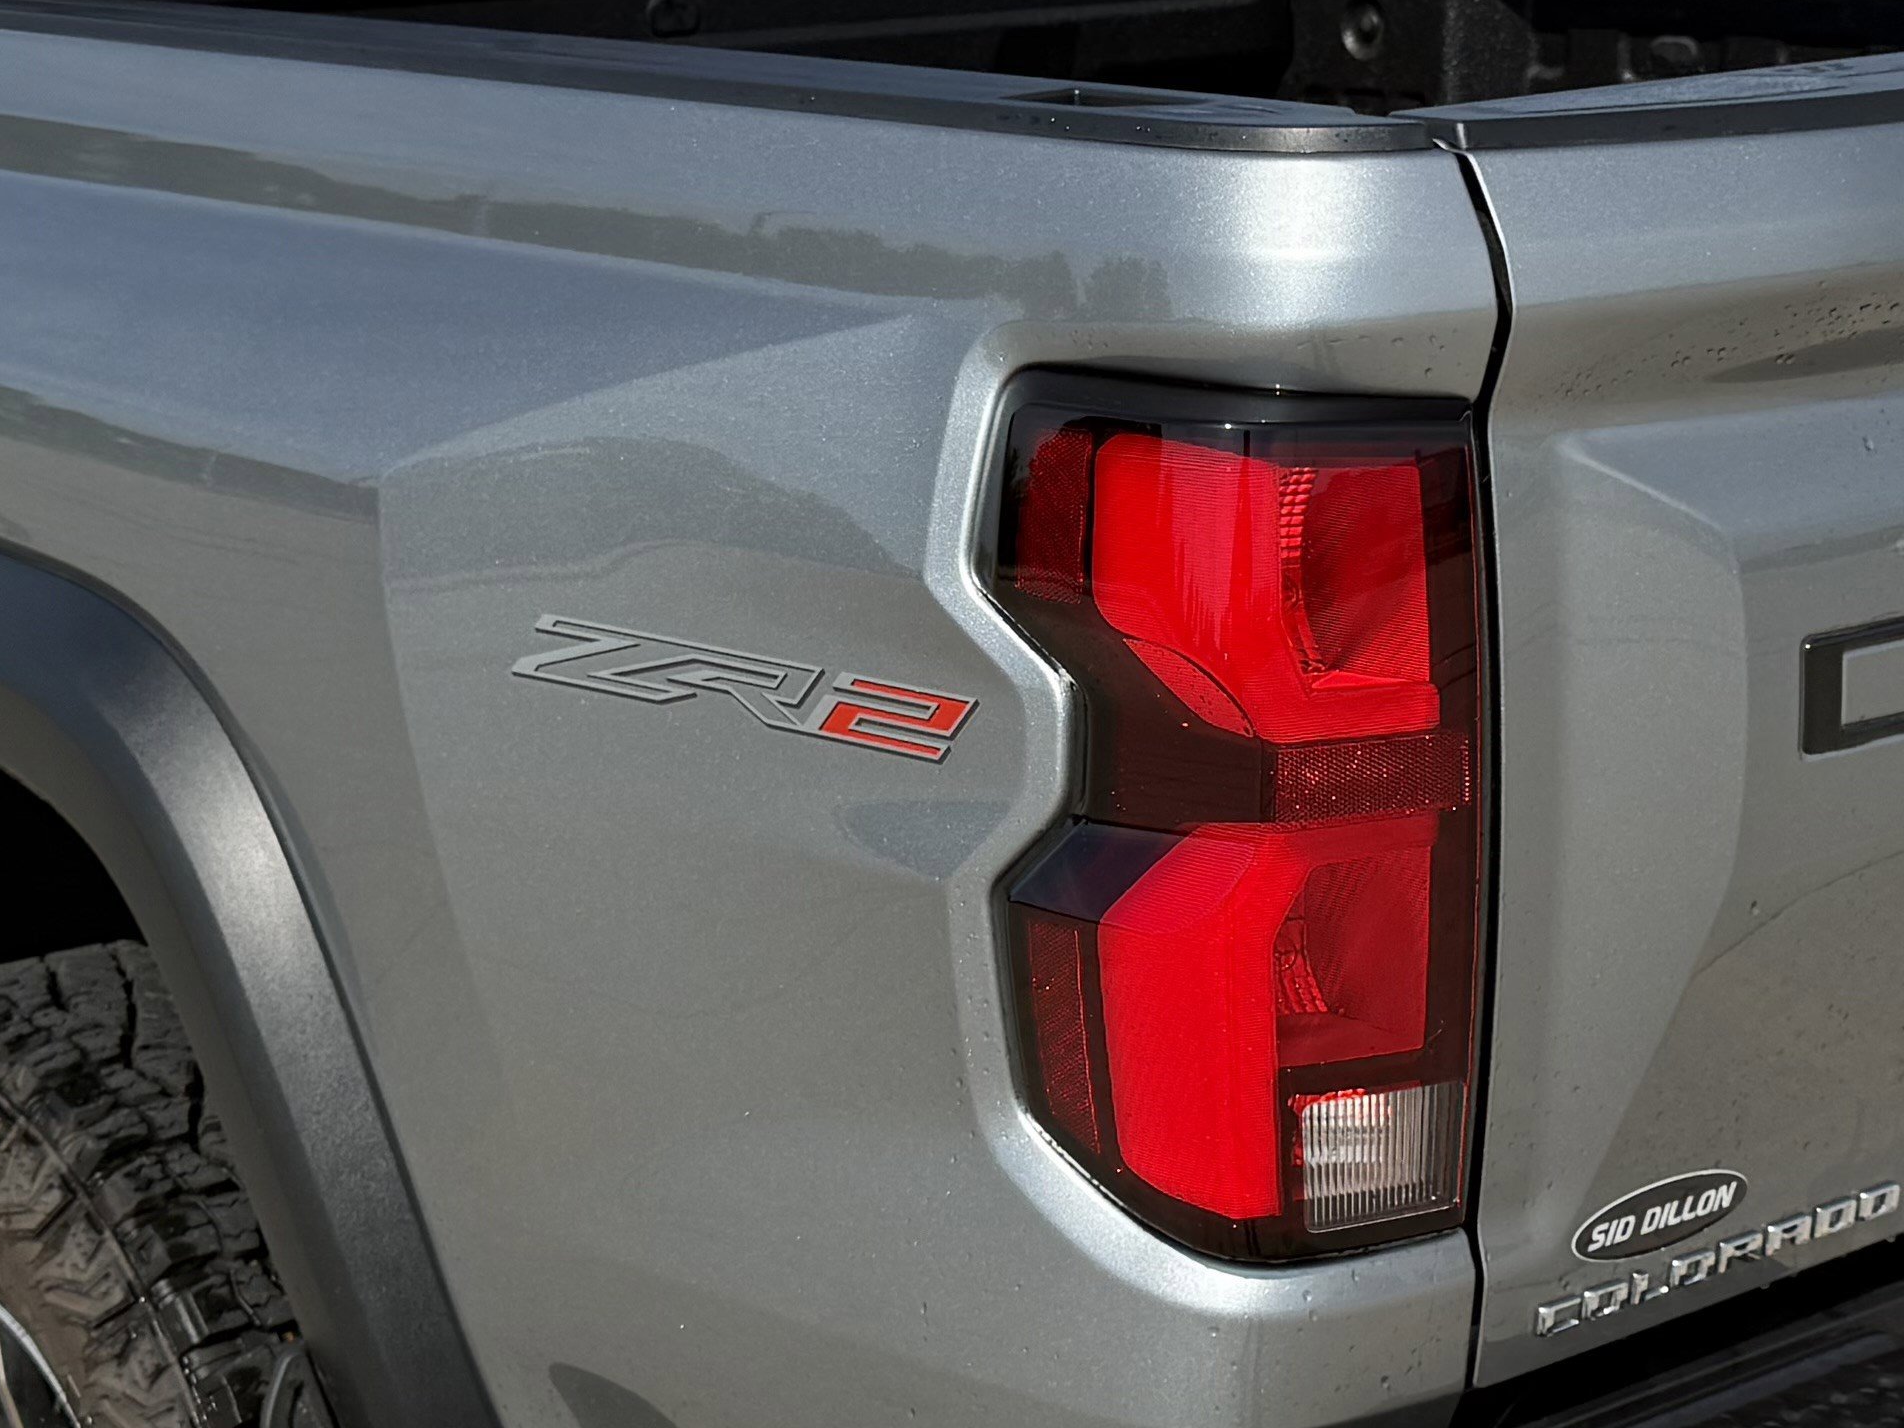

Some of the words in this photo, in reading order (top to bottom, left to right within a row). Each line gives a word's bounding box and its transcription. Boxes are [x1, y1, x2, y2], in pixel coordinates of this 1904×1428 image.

[510, 613, 981, 765] ZR2
[1537, 1180, 1900, 1336] COLORADO
[1587, 1214, 1637, 1253] SID
[1639, 1181, 1738, 1236] DILLON
